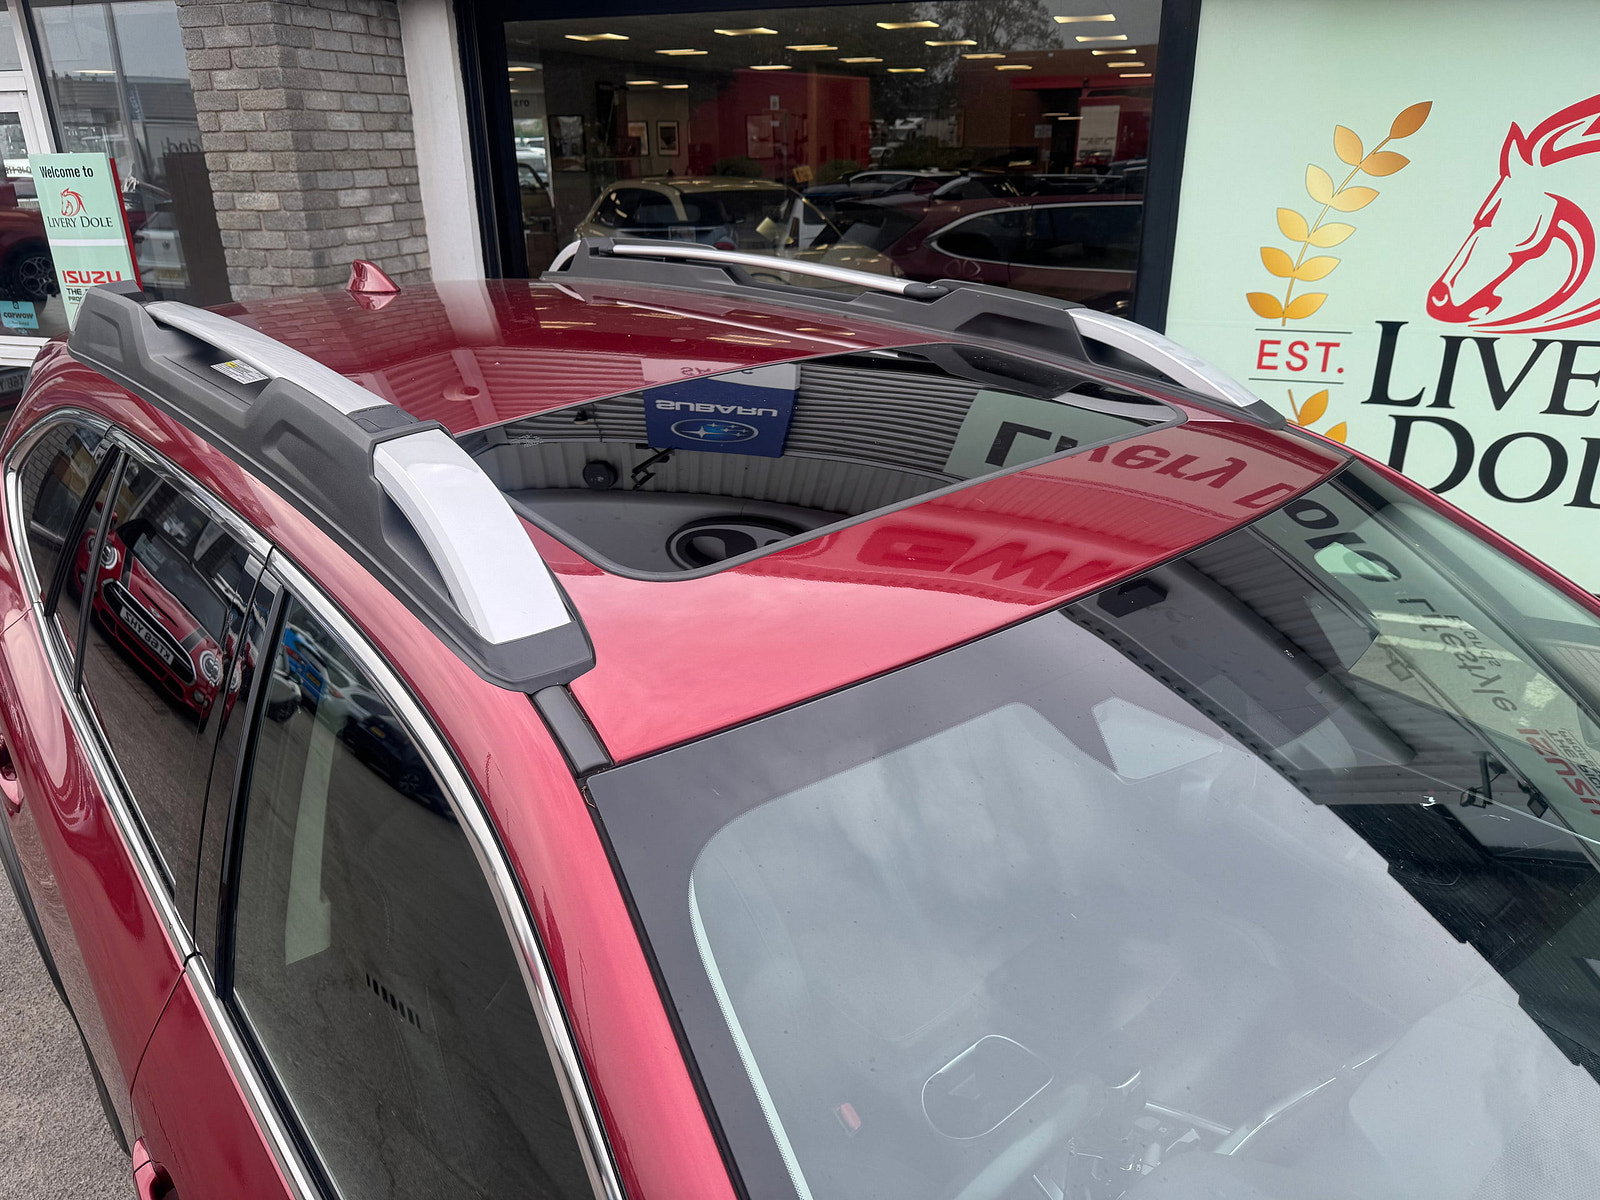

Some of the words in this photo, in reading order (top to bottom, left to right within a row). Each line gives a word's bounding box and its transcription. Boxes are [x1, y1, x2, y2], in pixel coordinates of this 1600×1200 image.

[39, 166, 80, 179] Welcome
[82, 166, 94, 178] to
[47, 215, 79, 228] LIVERY
[80, 215, 114, 228] DOLE
[62, 270, 122, 284] ISUZU
[66, 288, 83, 296] THE
[1256, 339, 1345, 374] EST.
[1361, 320, 1600, 417] LIVE
